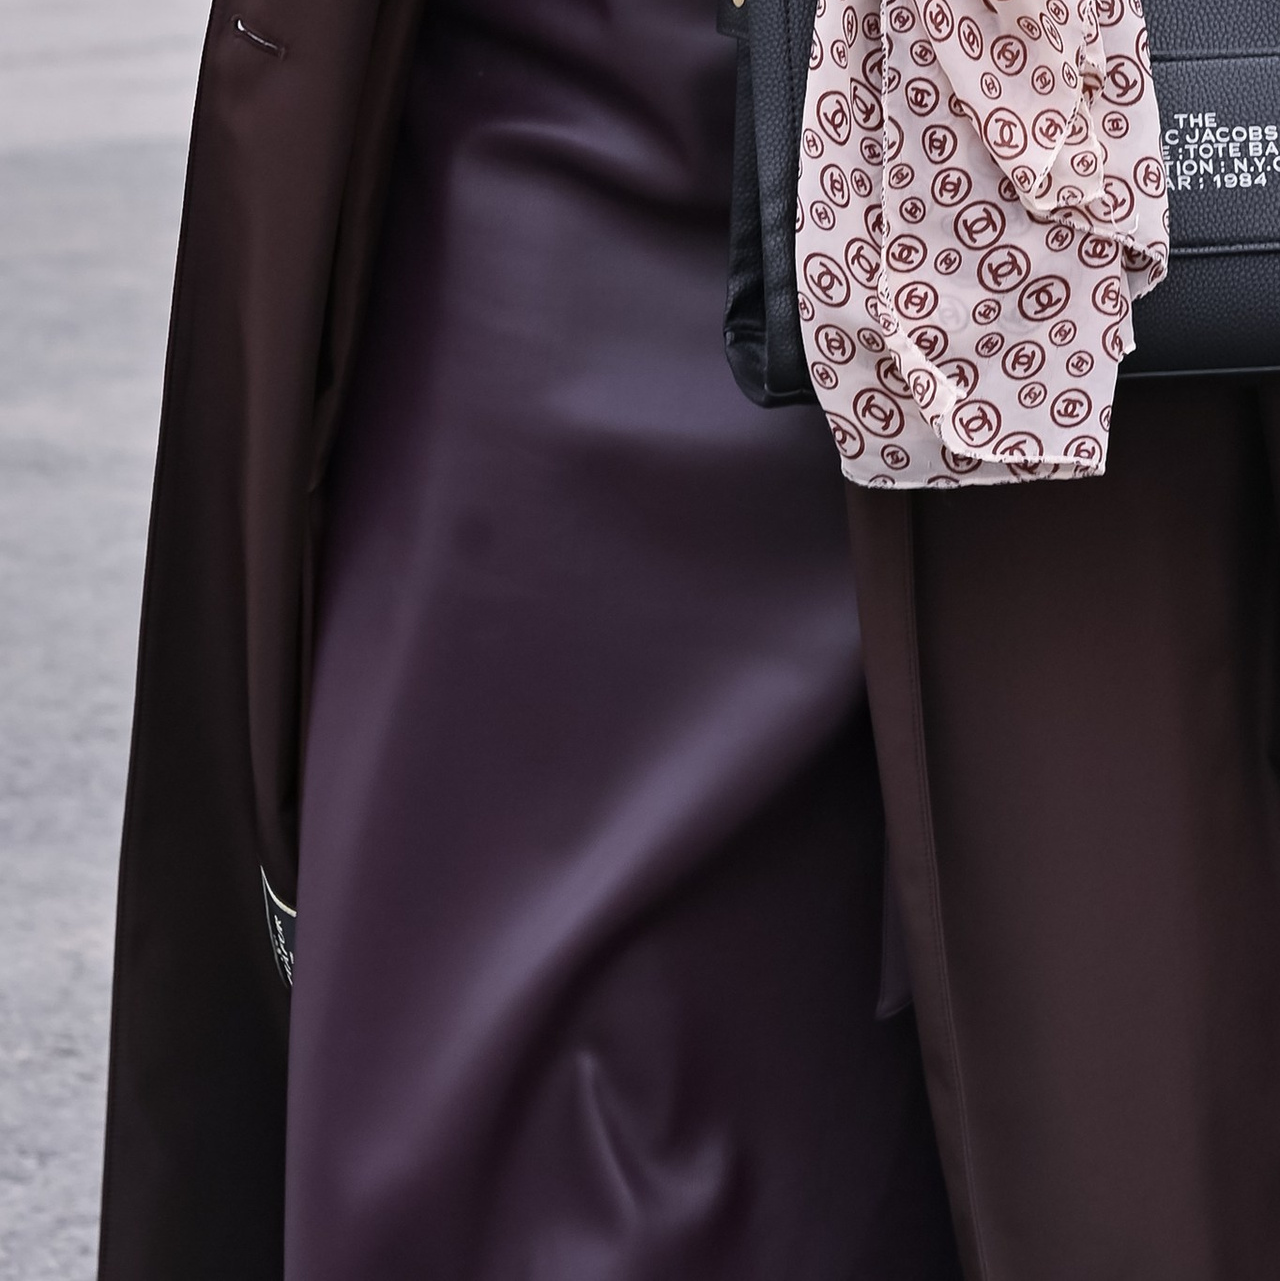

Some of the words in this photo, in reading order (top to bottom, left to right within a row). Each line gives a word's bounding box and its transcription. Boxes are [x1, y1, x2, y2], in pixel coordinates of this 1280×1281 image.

[1173, 112, 1217, 129] THE
[1164, 128, 1180, 145] C
[1185, 125, 1278, 144] JACOBS
[1163, 158, 1214, 176] TION
[1166, 175, 1192, 191] AR
[1213, 171, 1267, 189] 1984
